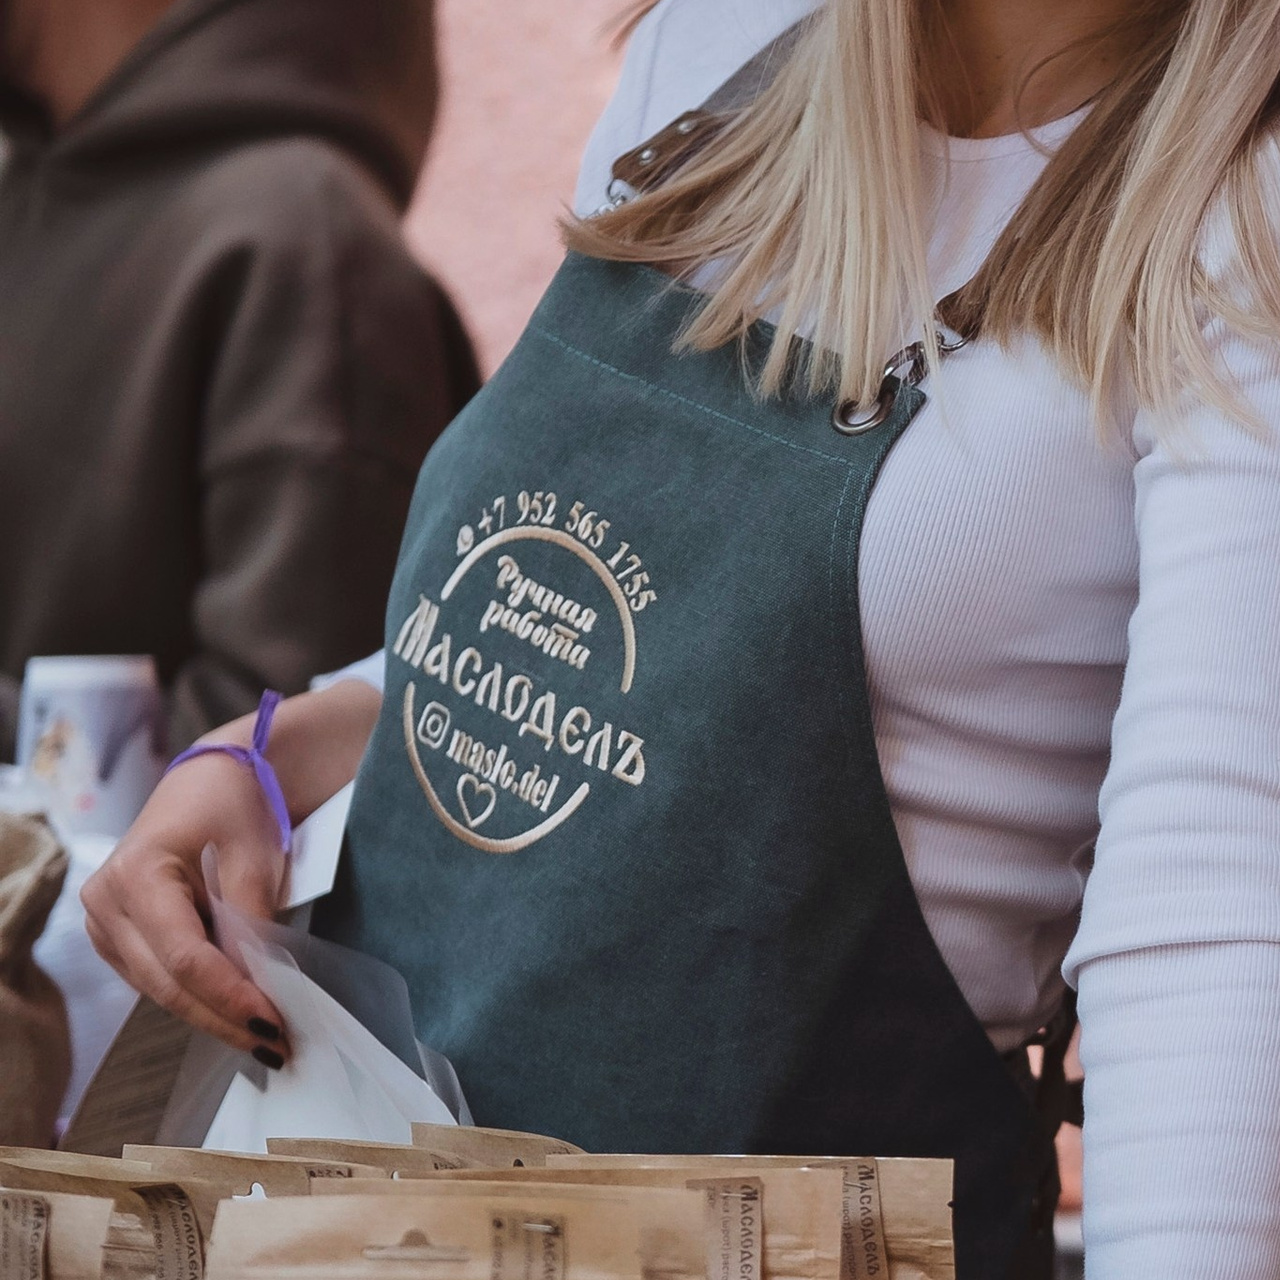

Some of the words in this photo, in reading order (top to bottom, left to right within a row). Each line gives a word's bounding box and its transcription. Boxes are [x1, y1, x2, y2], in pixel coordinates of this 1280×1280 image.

[478, 496, 506, 534] +7
[516, 490, 557, 525] 952
[565, 501, 611, 548] 565
[606, 541, 657, 611] 1755
[497, 555, 598, 633] Ручная
[480, 600, 591, 669] работа
